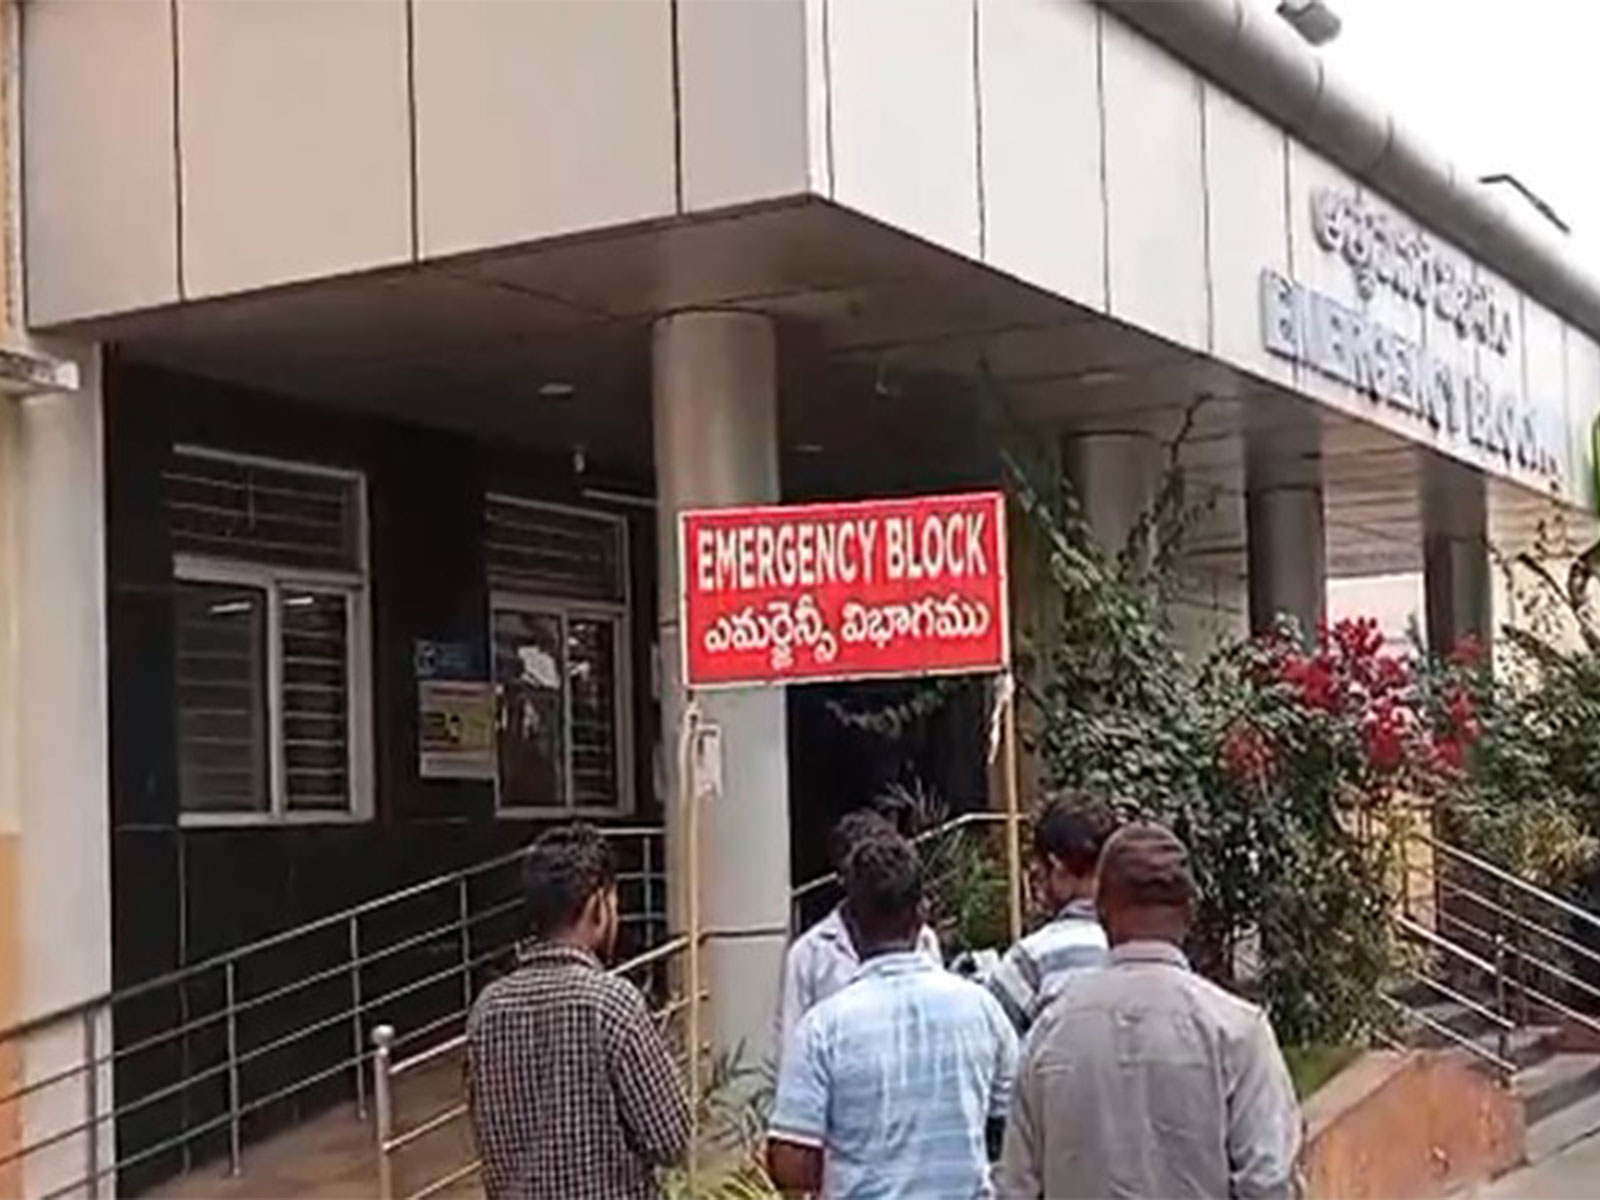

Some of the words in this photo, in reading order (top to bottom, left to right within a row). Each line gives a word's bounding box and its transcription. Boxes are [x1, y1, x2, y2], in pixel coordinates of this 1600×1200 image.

[698, 522, 878, 590] EMERGENCY
[885, 512, 988, 579] BLOCK
[841, 593, 990, 649] విభాగము
